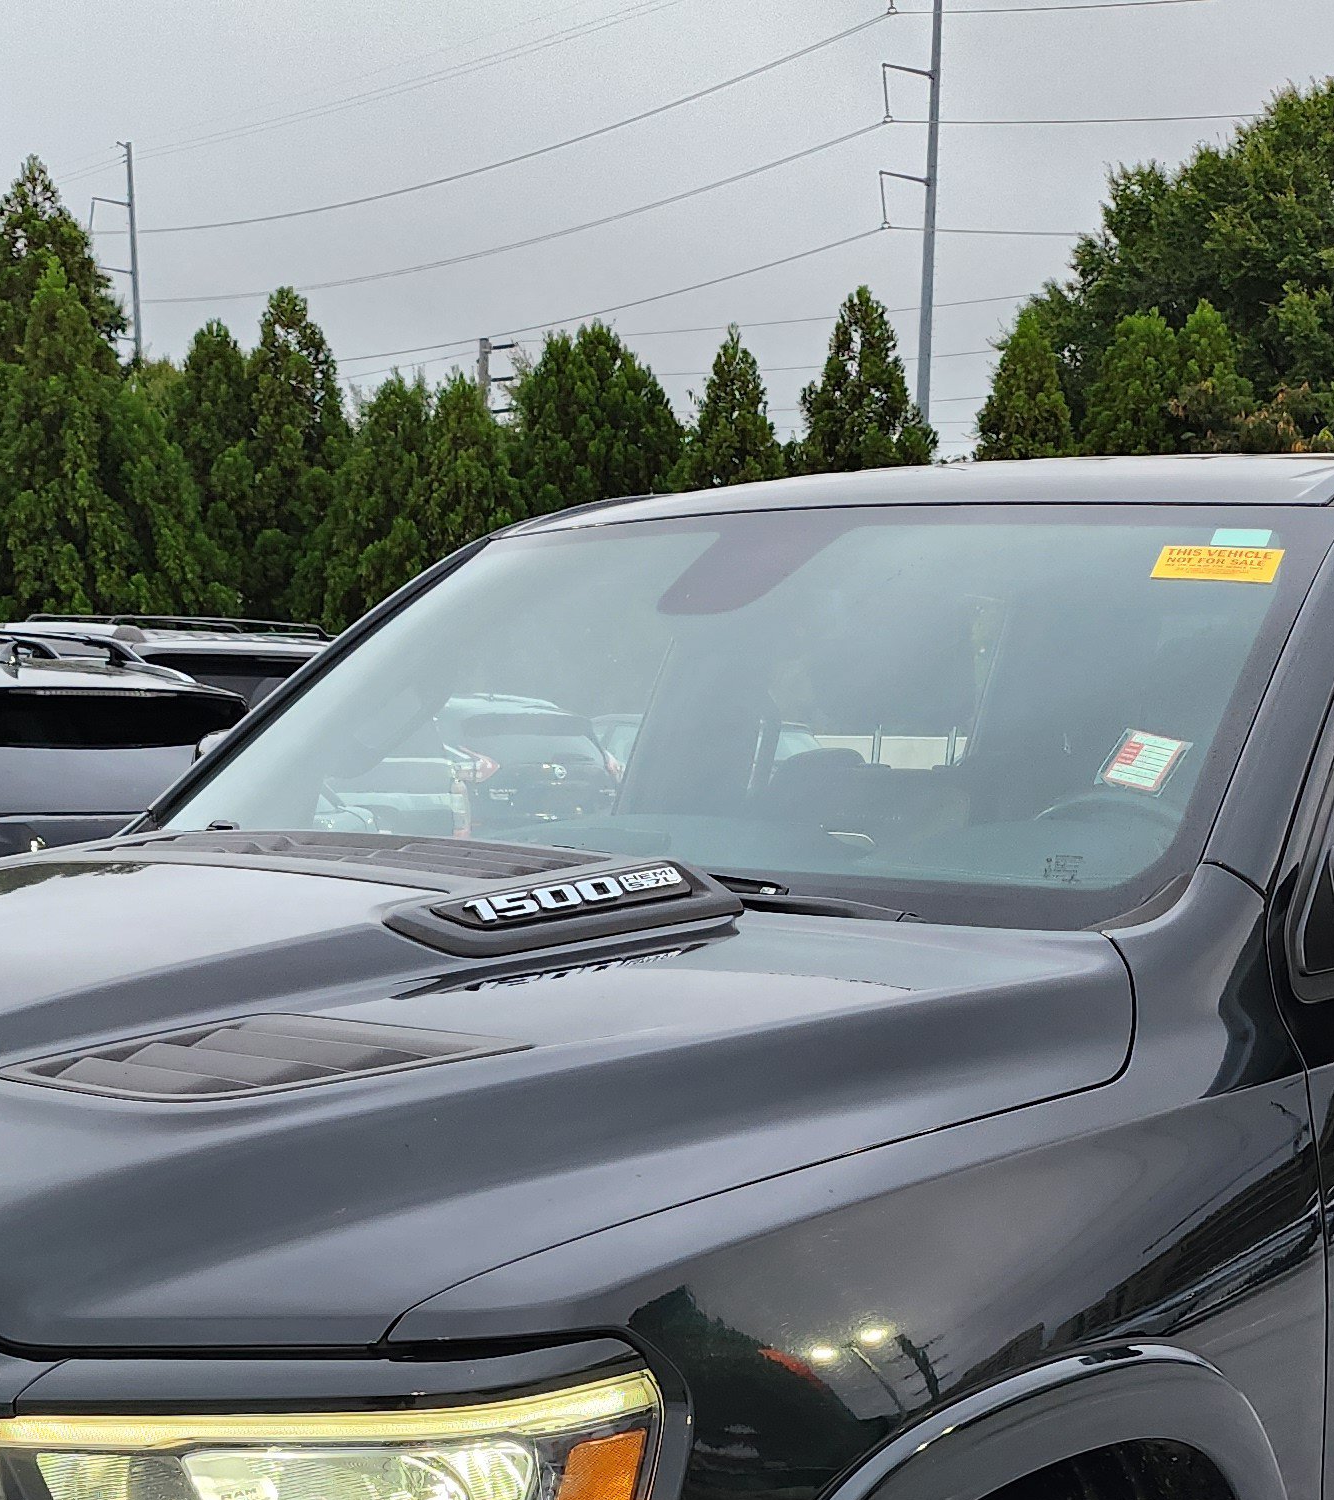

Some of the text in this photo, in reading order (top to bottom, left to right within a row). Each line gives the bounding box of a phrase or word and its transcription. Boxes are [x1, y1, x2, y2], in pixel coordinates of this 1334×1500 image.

[1168, 548, 1275, 560] THIS VEHICLE
[1198, 557, 1226, 565] FOR
[1230, 558, 1267, 567] SALE
[622, 867, 676, 883] HEMI
[627, 876, 680, 891] 5.7L
[463, 875, 624, 923] 1500
[220, 1488, 257, 1500] RAM
